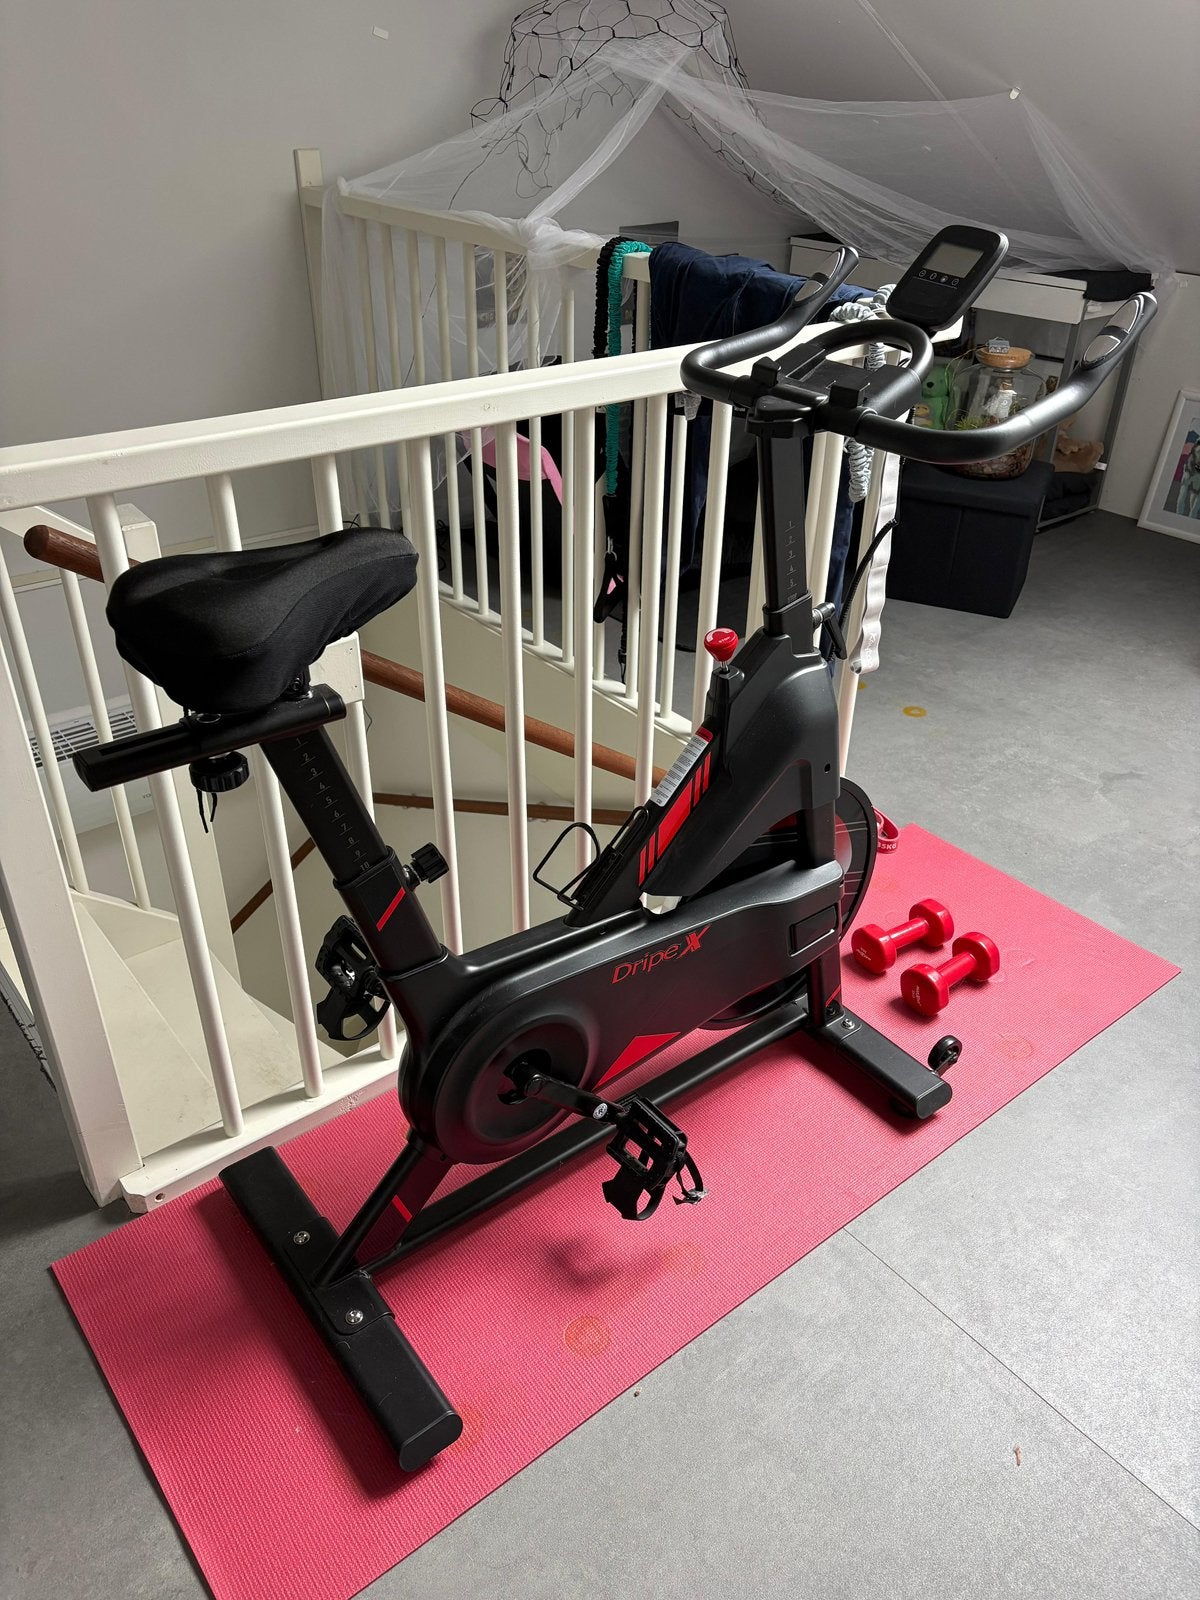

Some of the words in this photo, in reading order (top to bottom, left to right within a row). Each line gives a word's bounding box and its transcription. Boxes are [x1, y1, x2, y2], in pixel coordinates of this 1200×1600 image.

[302, 752, 310, 761] 2
[310, 767, 318, 776] 3
[325, 796, 333, 804] 5
[334, 810, 341, 818] 6
[340, 823, 348, 831] 7
[348, 837, 355, 845] 8
[355, 850, 361, 858] 9
[360, 861, 371, 871] 10
